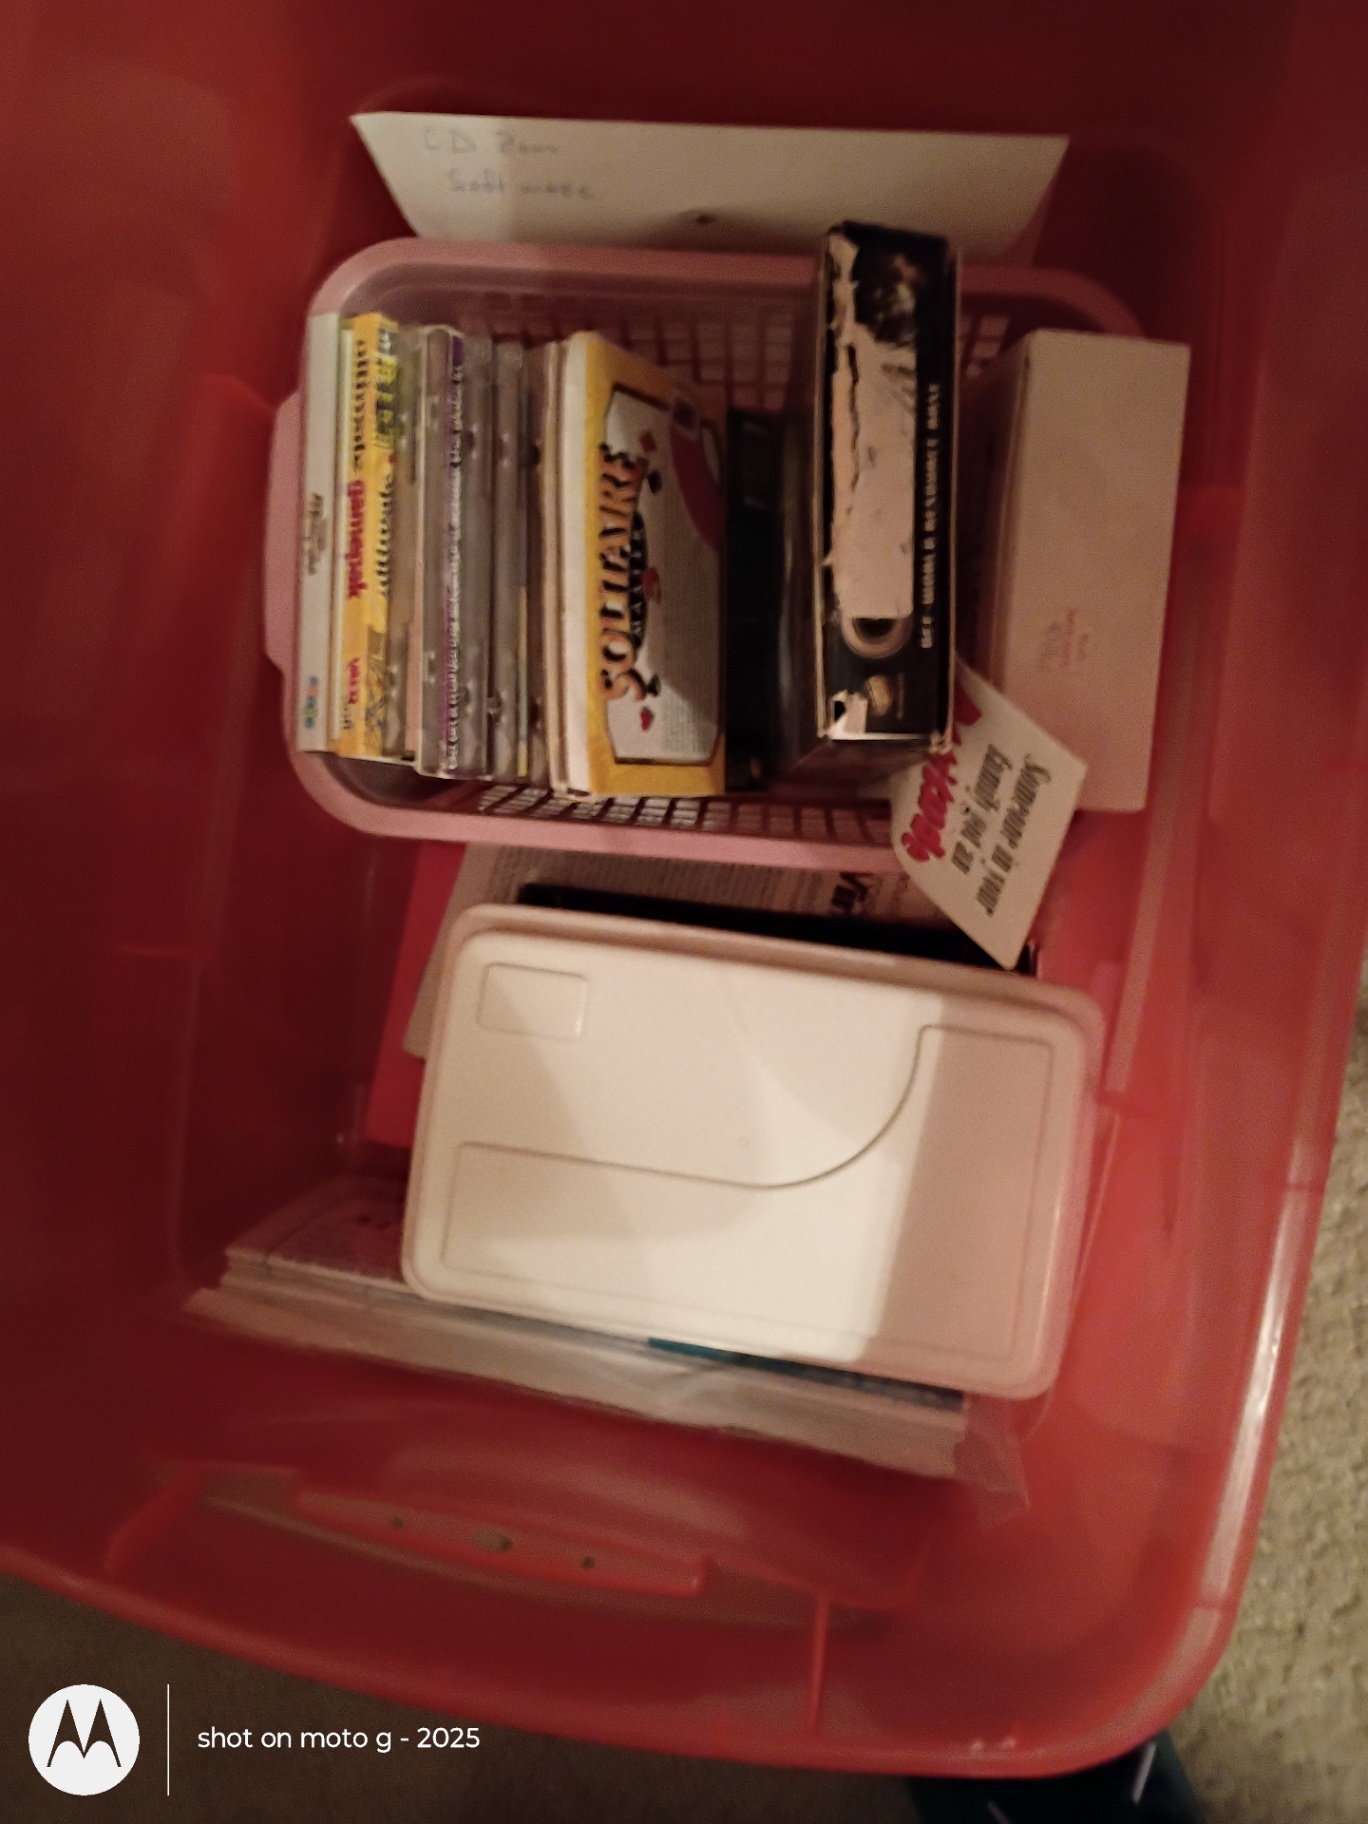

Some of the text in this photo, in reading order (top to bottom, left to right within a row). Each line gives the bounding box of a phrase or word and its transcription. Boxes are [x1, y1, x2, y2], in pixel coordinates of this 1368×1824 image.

[598, 442, 648, 702] SOLITAIRE
[951, 743, 1013, 875] family got an
[976, 753, 1051, 917] Someone in your
